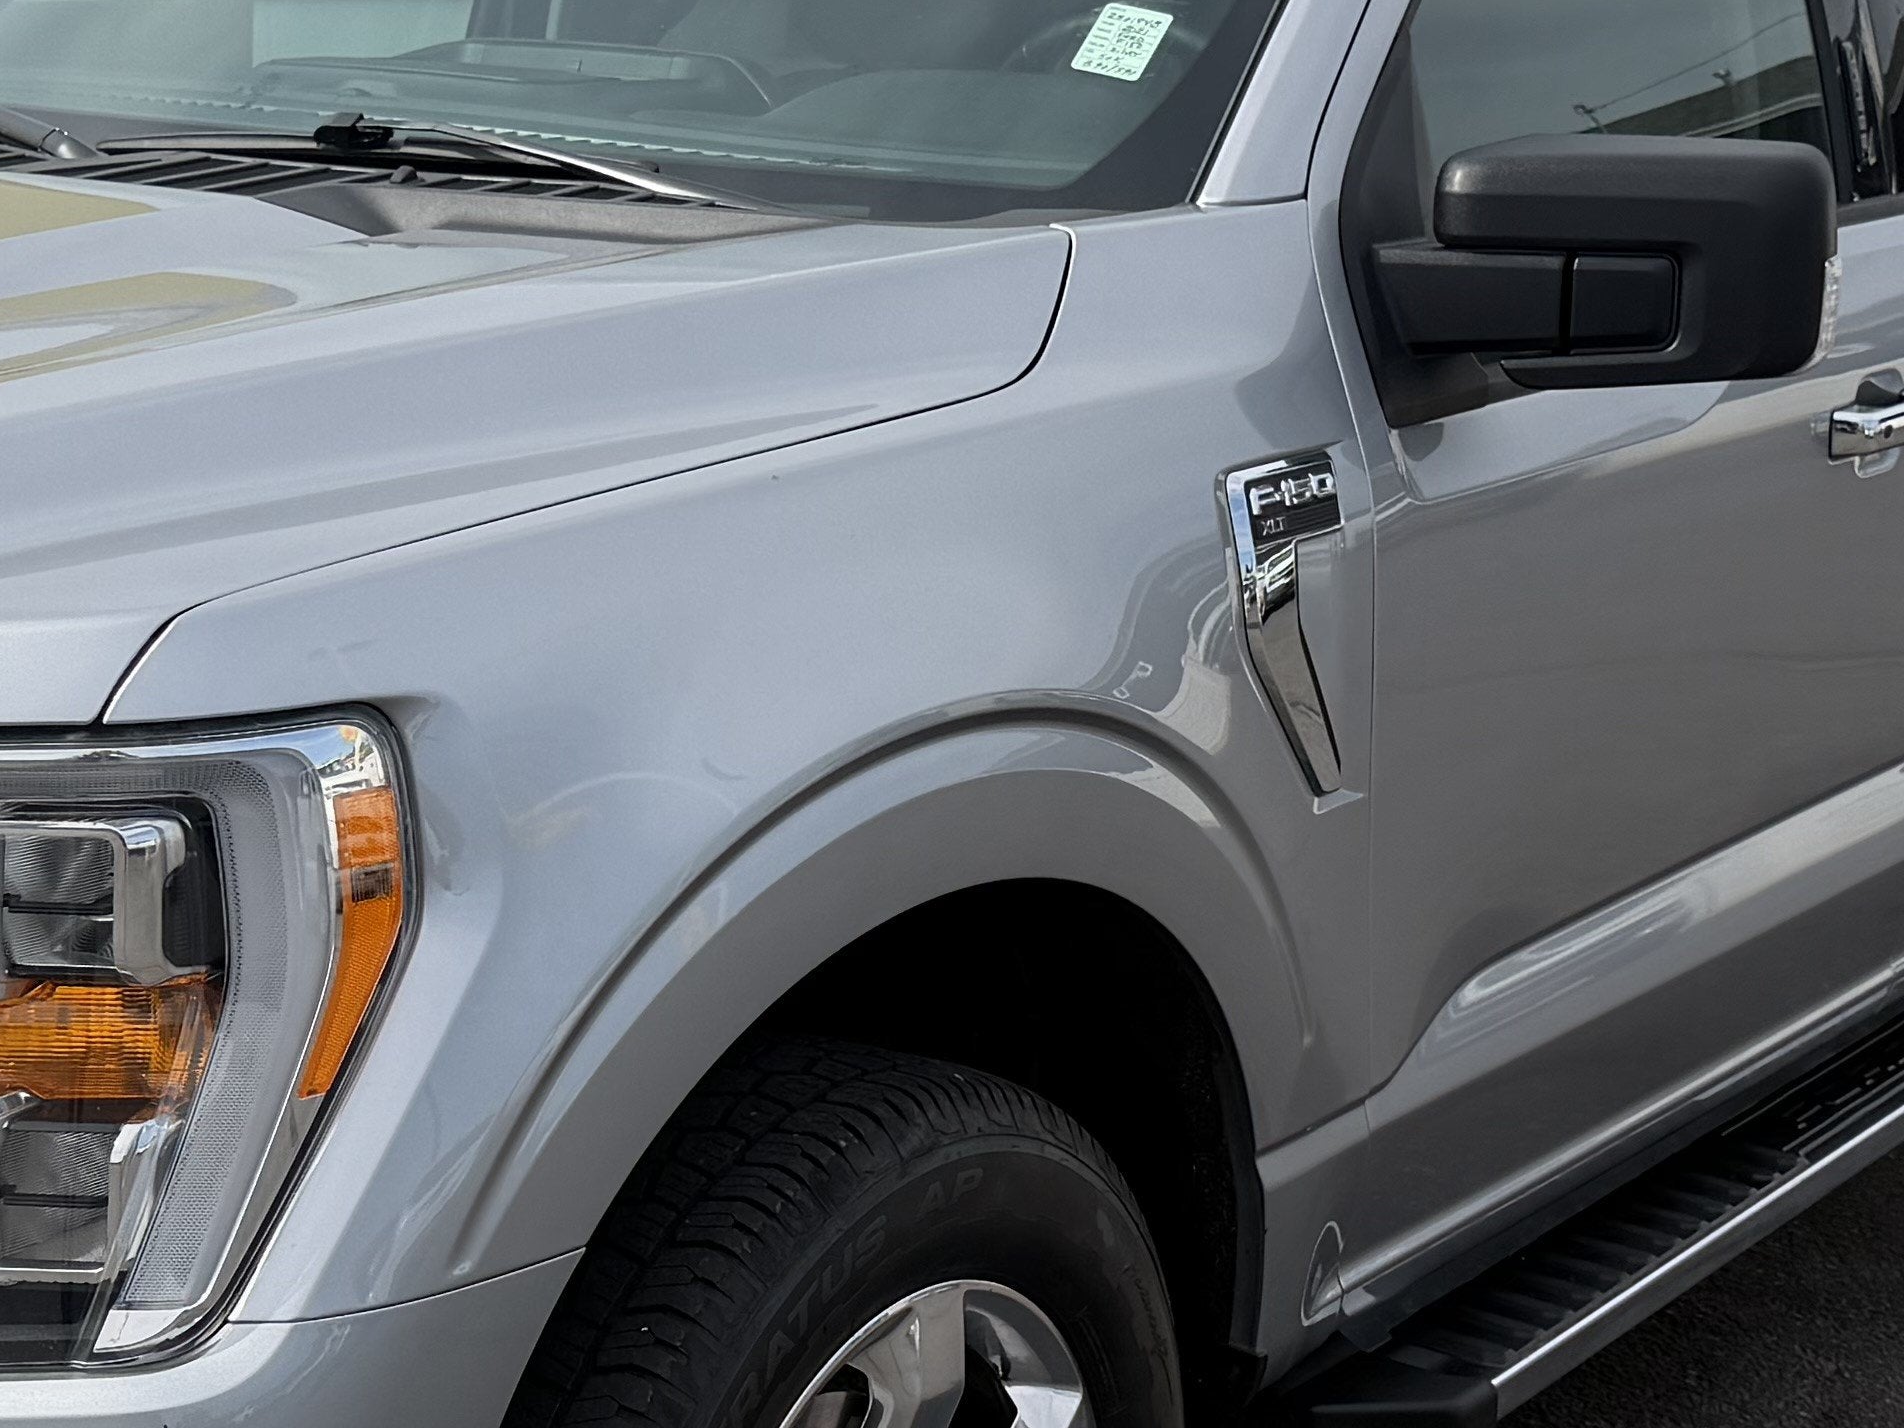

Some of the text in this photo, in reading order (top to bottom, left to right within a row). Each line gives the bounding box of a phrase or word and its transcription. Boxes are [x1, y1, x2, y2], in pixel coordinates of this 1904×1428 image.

[1249, 472, 1334, 515] F-150
[1260, 516, 1286, 537] XLT
[915, 1166, 985, 1215] AP
